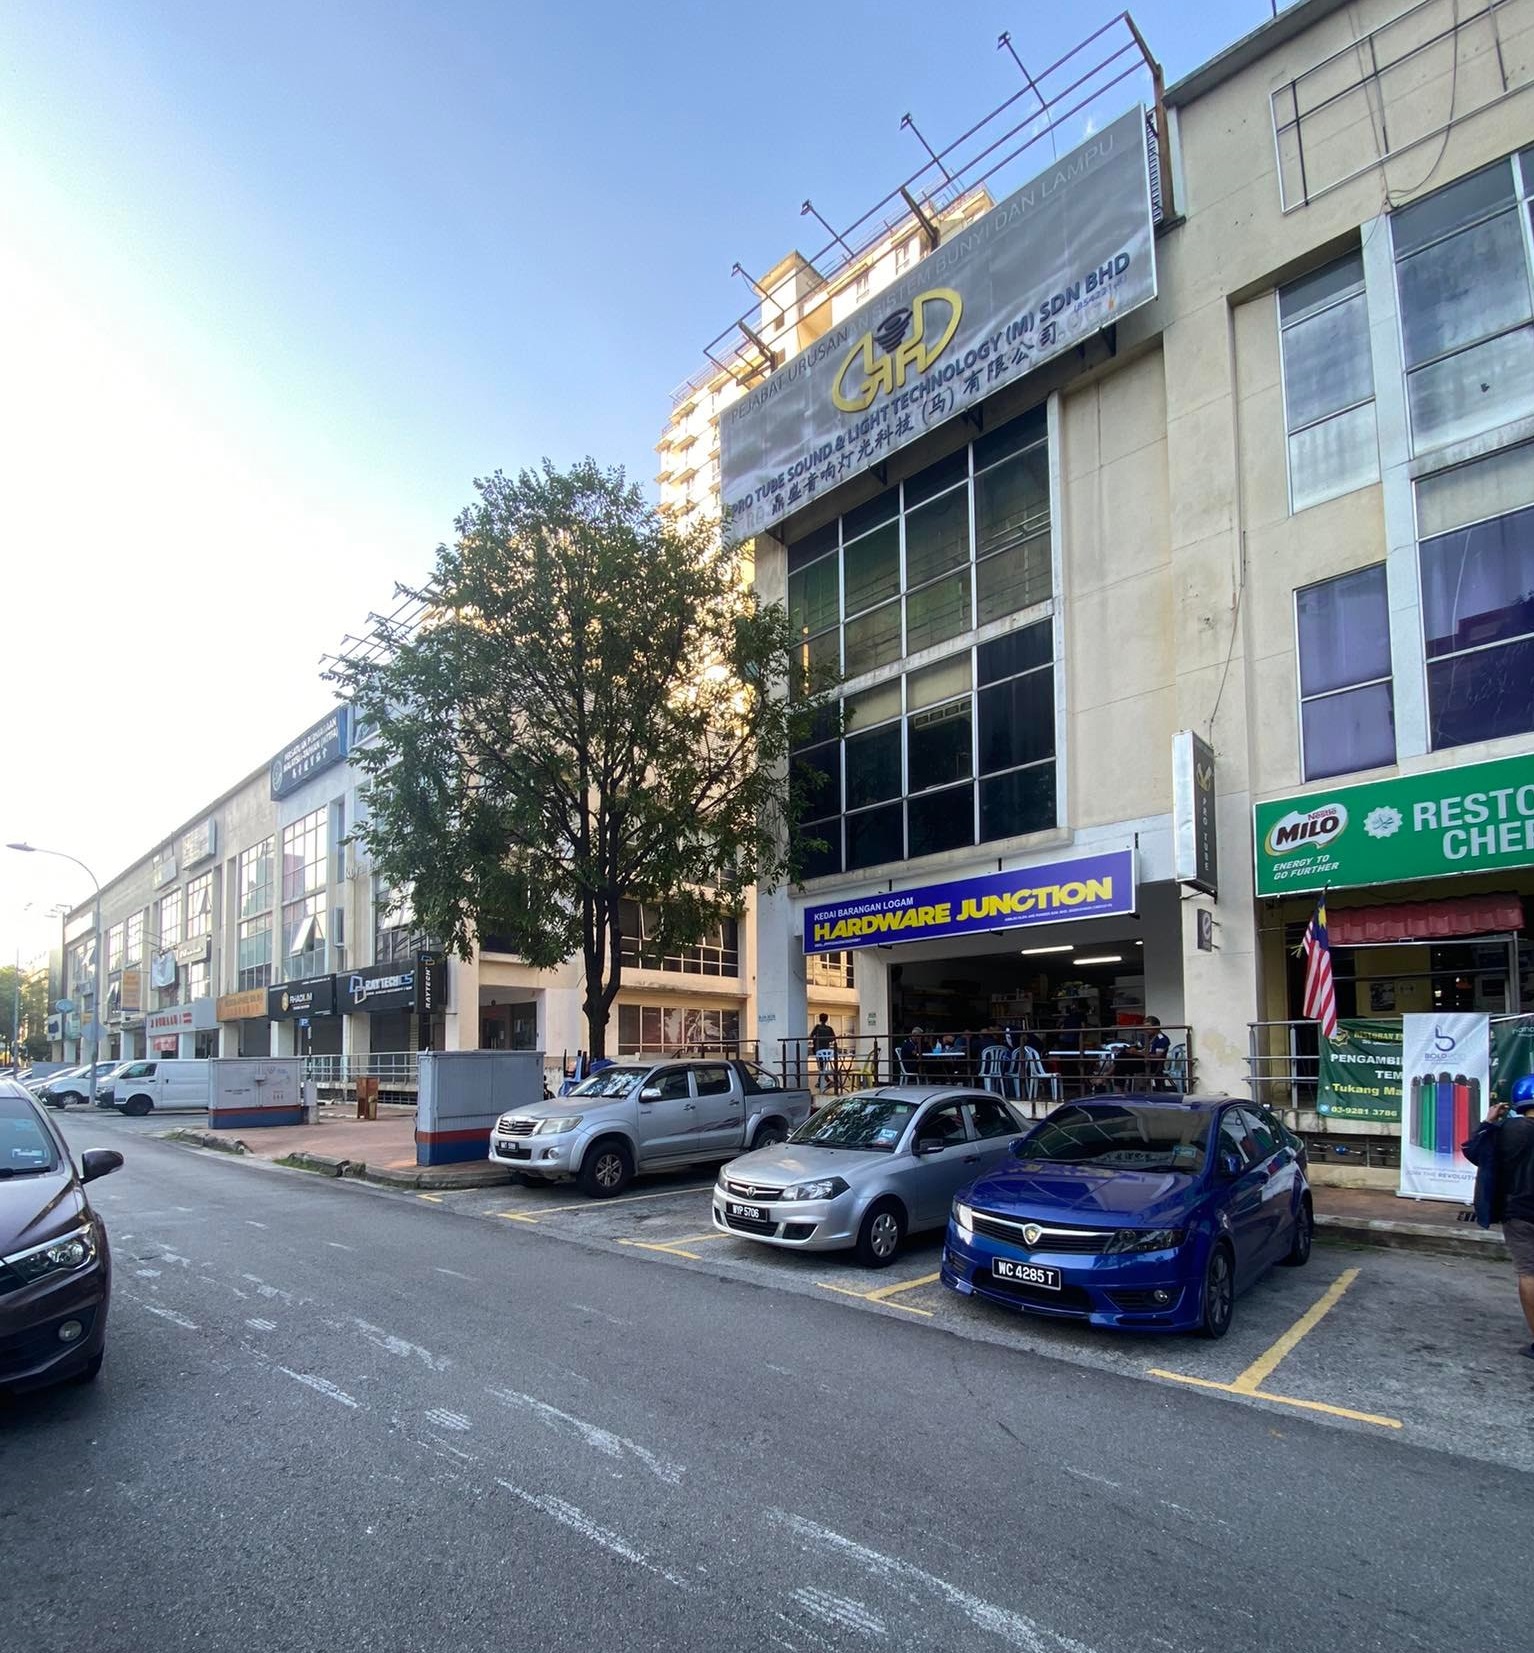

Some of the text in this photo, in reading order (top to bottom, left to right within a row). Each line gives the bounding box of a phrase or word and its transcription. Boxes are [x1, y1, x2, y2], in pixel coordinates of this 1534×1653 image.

[731, 373, 783, 424] PEJABAT
[936, 223, 989, 273] BUNYI
[995, 190, 1035, 232] DAN
[1042, 134, 1113, 198] LAMPU
[755, 471, 785, 502] TUBE
[787, 442, 833, 483] SOUND
[835, 434, 845, 452] &
[847, 404, 889, 444] LIGHT
[891, 331, 1003, 416] TECHNOLOGY
[1006, 311, 1035, 345] (M)
[1040, 281, 1080, 323] SDN
[1085, 252, 1130, 294] BHD
[1276, 816, 1339, 846] MILO
[1273, 854, 1330, 872] ENERGY TO
[1274, 862, 1340, 880] GO FURTHER
[814, 897, 914, 921] KEDAI BARANGAN LOGAM
[814, 903, 951, 942] HARDWARE
[957, 876, 1113, 922] JUNCTION
[1330, 1053, 1403, 1066] PENGAMBI
[1332, 1083, 1380, 1097] Tukang
[1331, 1105, 1369, 1115] 03-9281
[744, 1206, 760, 1219] 5706
[998, 1261, 1054, 1285] WC 4285 T
